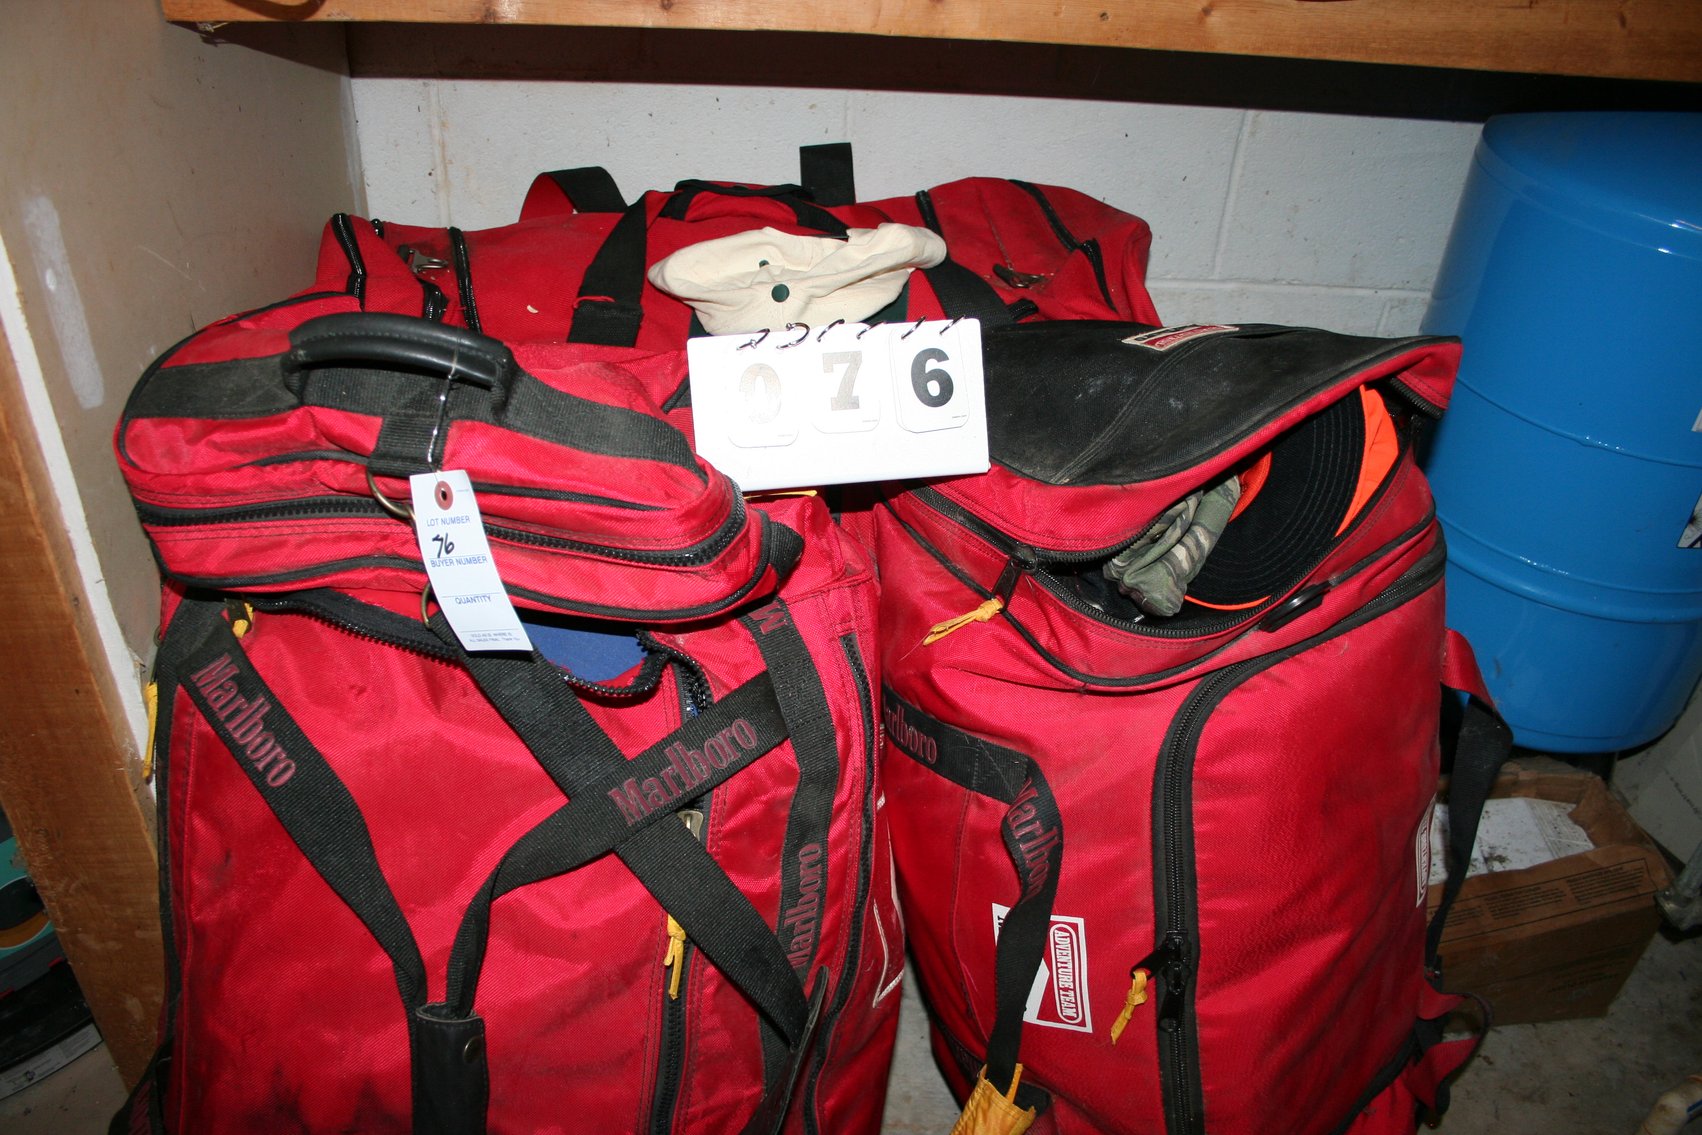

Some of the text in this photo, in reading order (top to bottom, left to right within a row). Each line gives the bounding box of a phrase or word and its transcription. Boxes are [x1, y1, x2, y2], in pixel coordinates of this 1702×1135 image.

[426, 515, 470, 527] LOT NUMBER
[432, 532, 455, 559] 76
[430, 555, 488, 568] BUYER NUMBER
[455, 595, 492, 605] QUANTITY
[190, 652, 296, 788] Marlboro
[608, 718, 758, 826] Marlboro
[1054, 929, 1078, 1018] ADVENTURE TEAM
